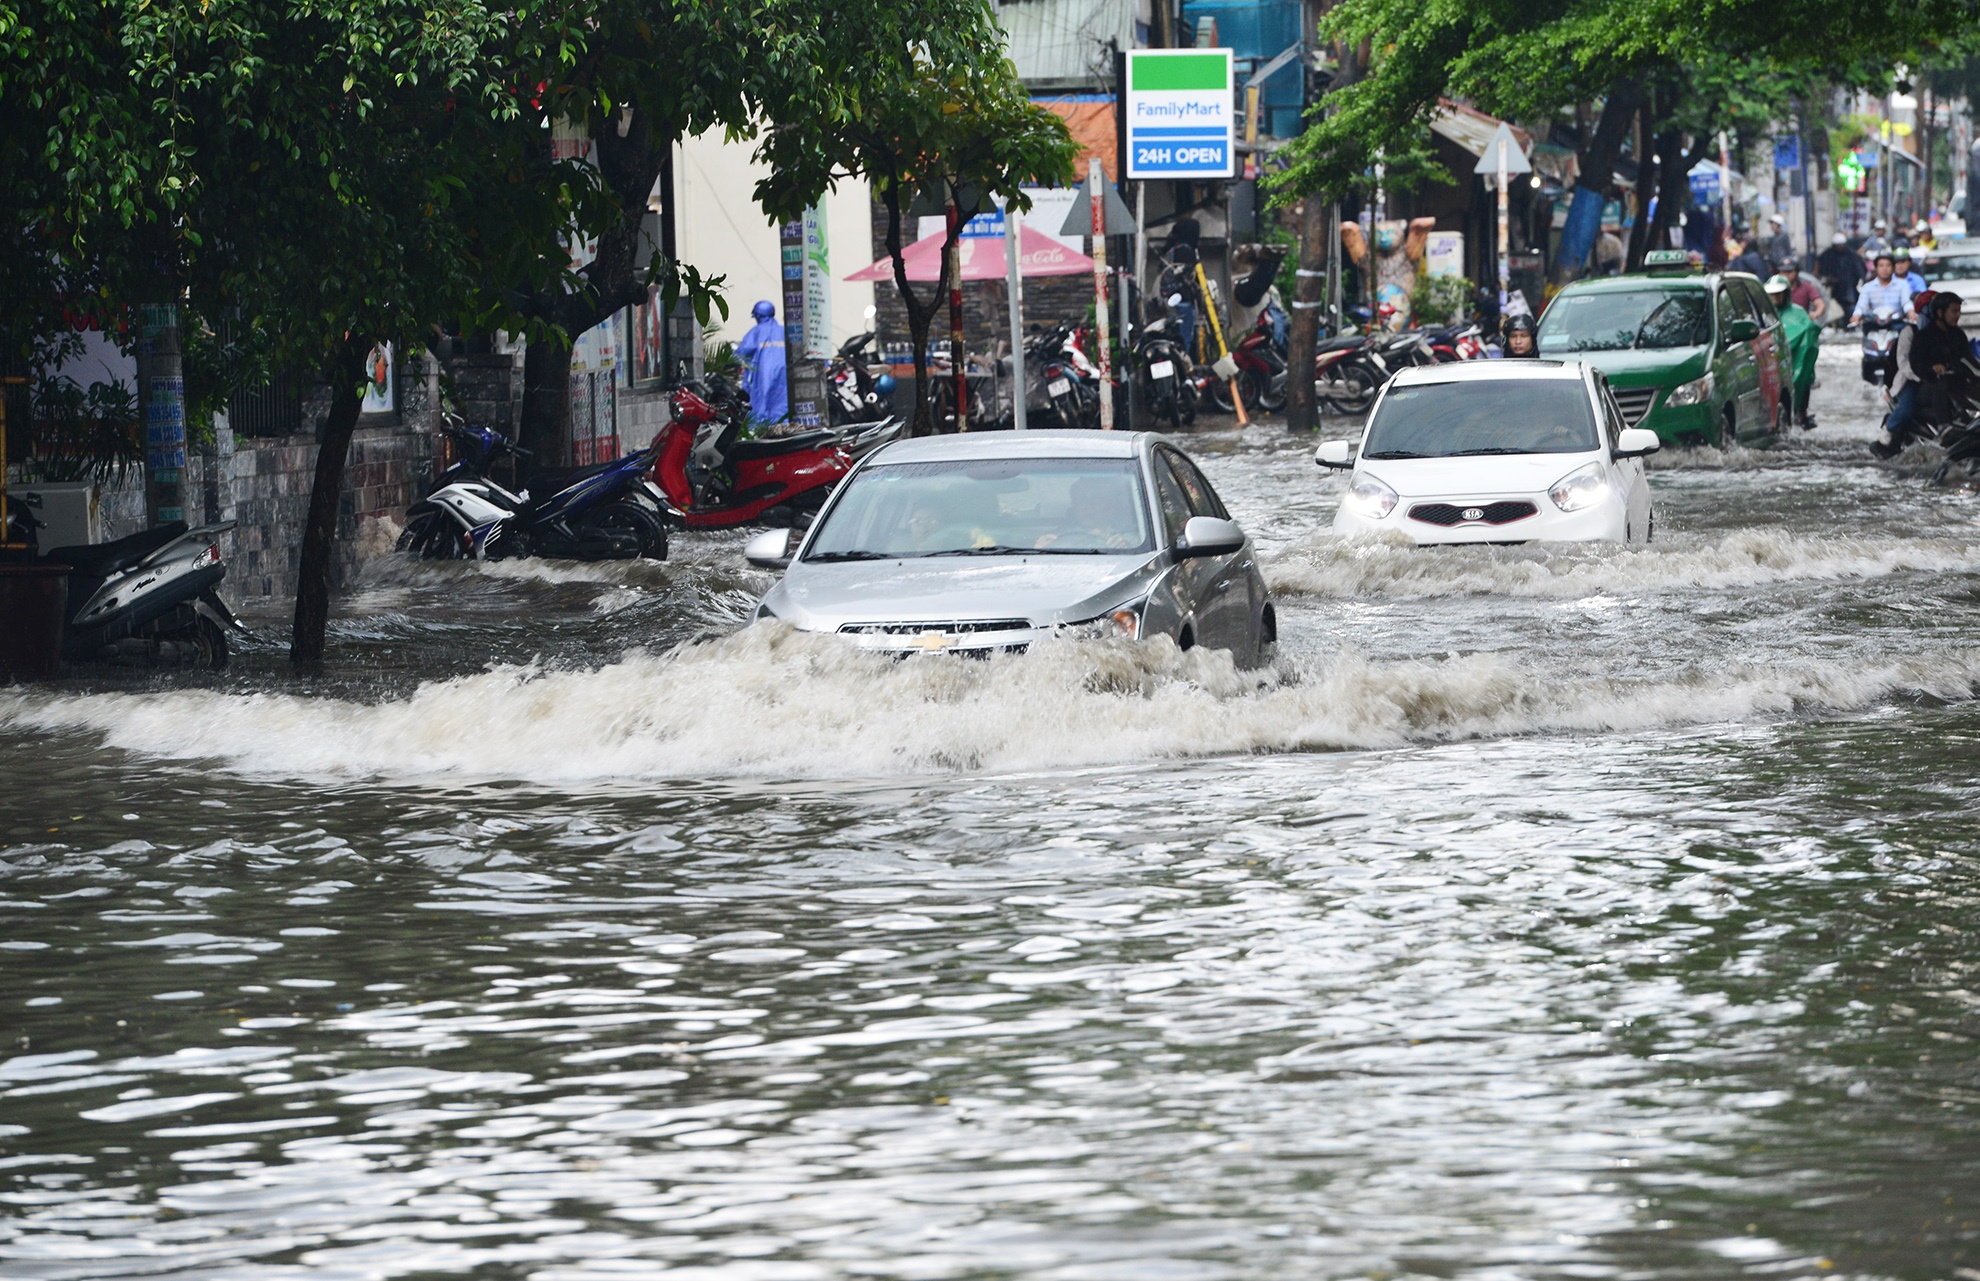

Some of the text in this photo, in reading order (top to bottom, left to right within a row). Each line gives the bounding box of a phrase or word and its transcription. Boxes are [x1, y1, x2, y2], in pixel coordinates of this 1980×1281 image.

[1137, 102, 1221, 119] FamilyMart
[1137, 147, 1222, 164] 24H OPEN
[1649, 251, 1683, 262] TAXI
